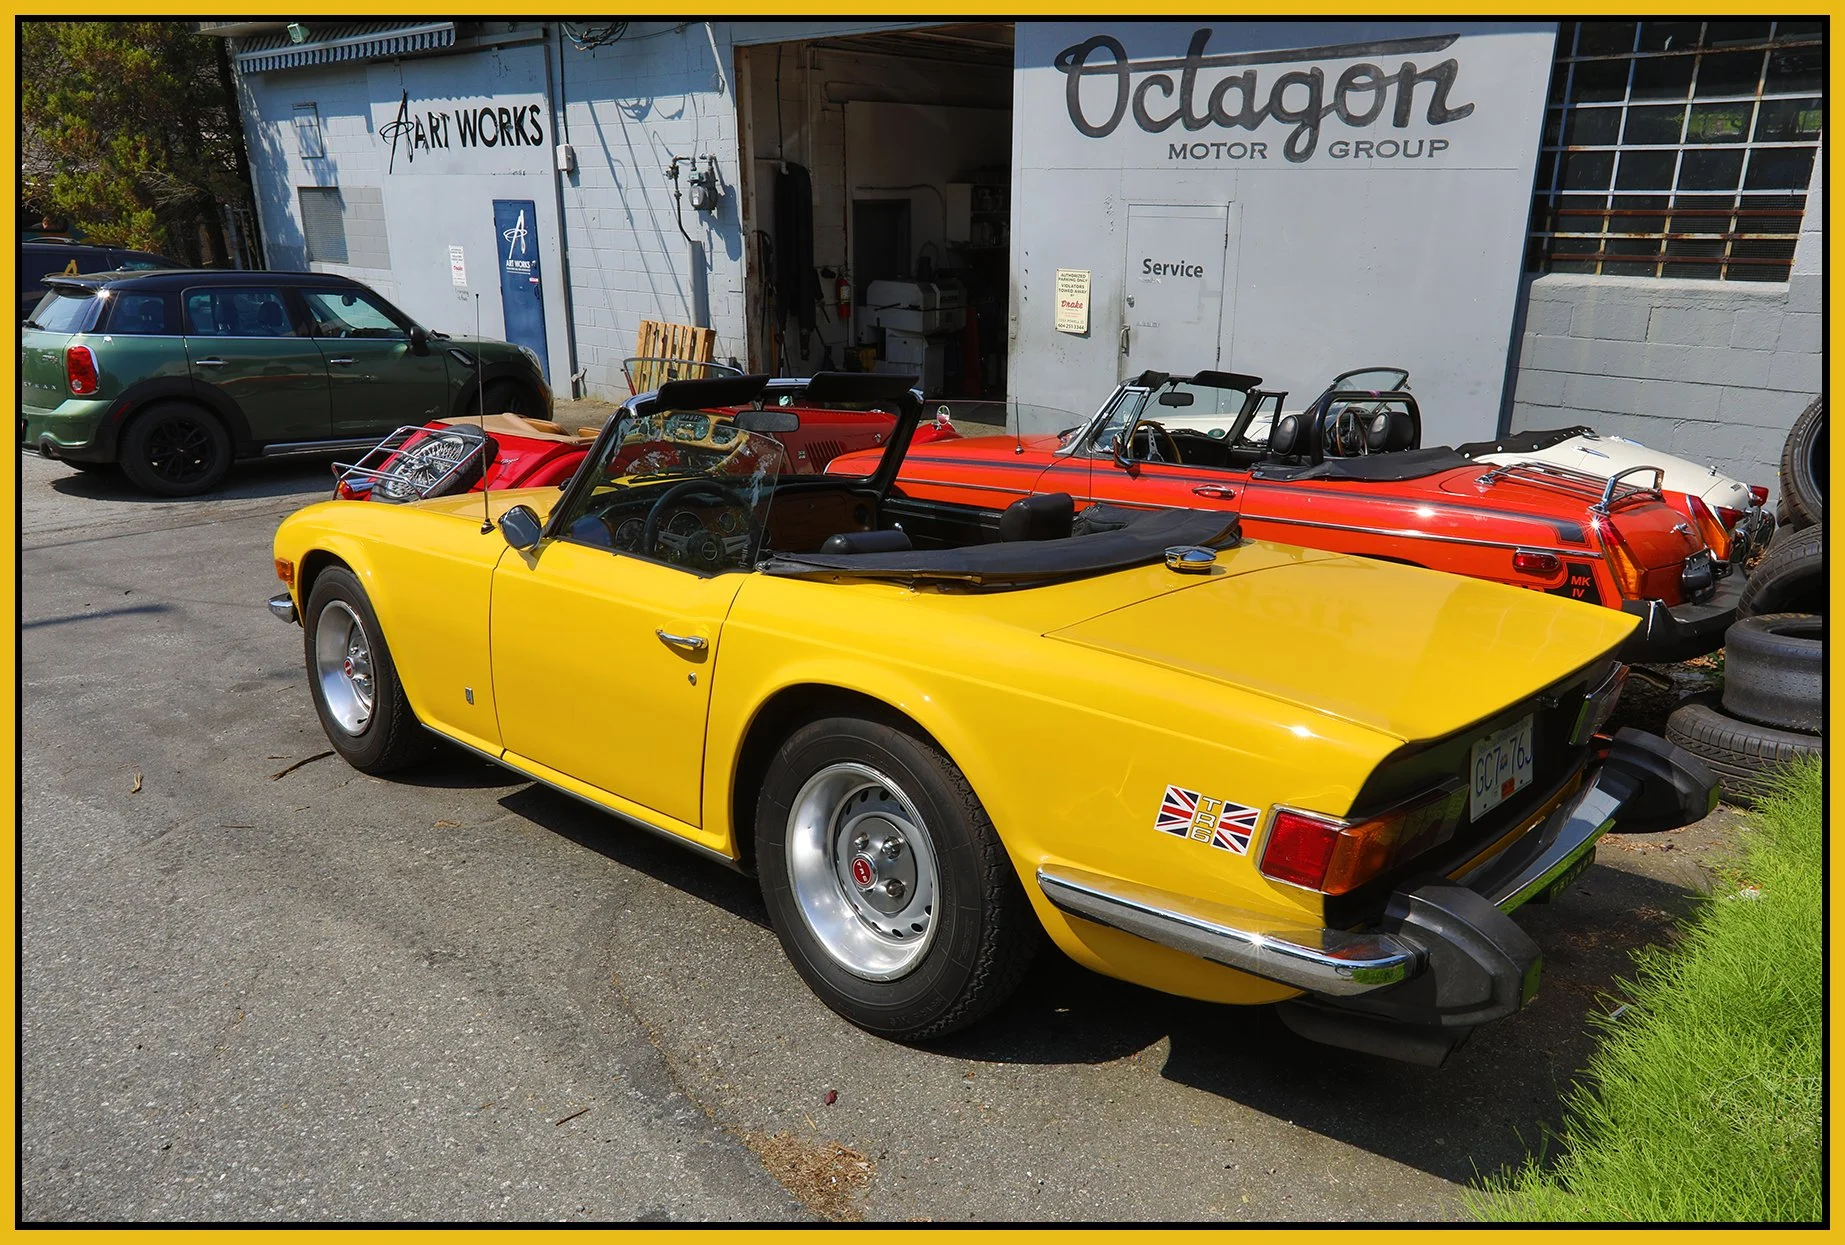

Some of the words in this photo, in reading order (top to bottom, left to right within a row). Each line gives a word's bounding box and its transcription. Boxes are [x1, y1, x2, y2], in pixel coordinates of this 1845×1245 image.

[1054, 27, 1475, 163] Octagon
[414, 111, 450, 151] ART
[454, 104, 544, 148] WORKS
[1168, 141, 1268, 160] MOTOR
[1328, 139, 1450, 158] GROUP
[1142, 258, 1204, 278] Service
[1061, 300, 1084, 309] Drake
[1570, 575, 1591, 587] MK
[1572, 588, 1586, 598] IV
[1475, 745, 1501, 798] GC7
[1191, 796, 1222, 843] TR6
